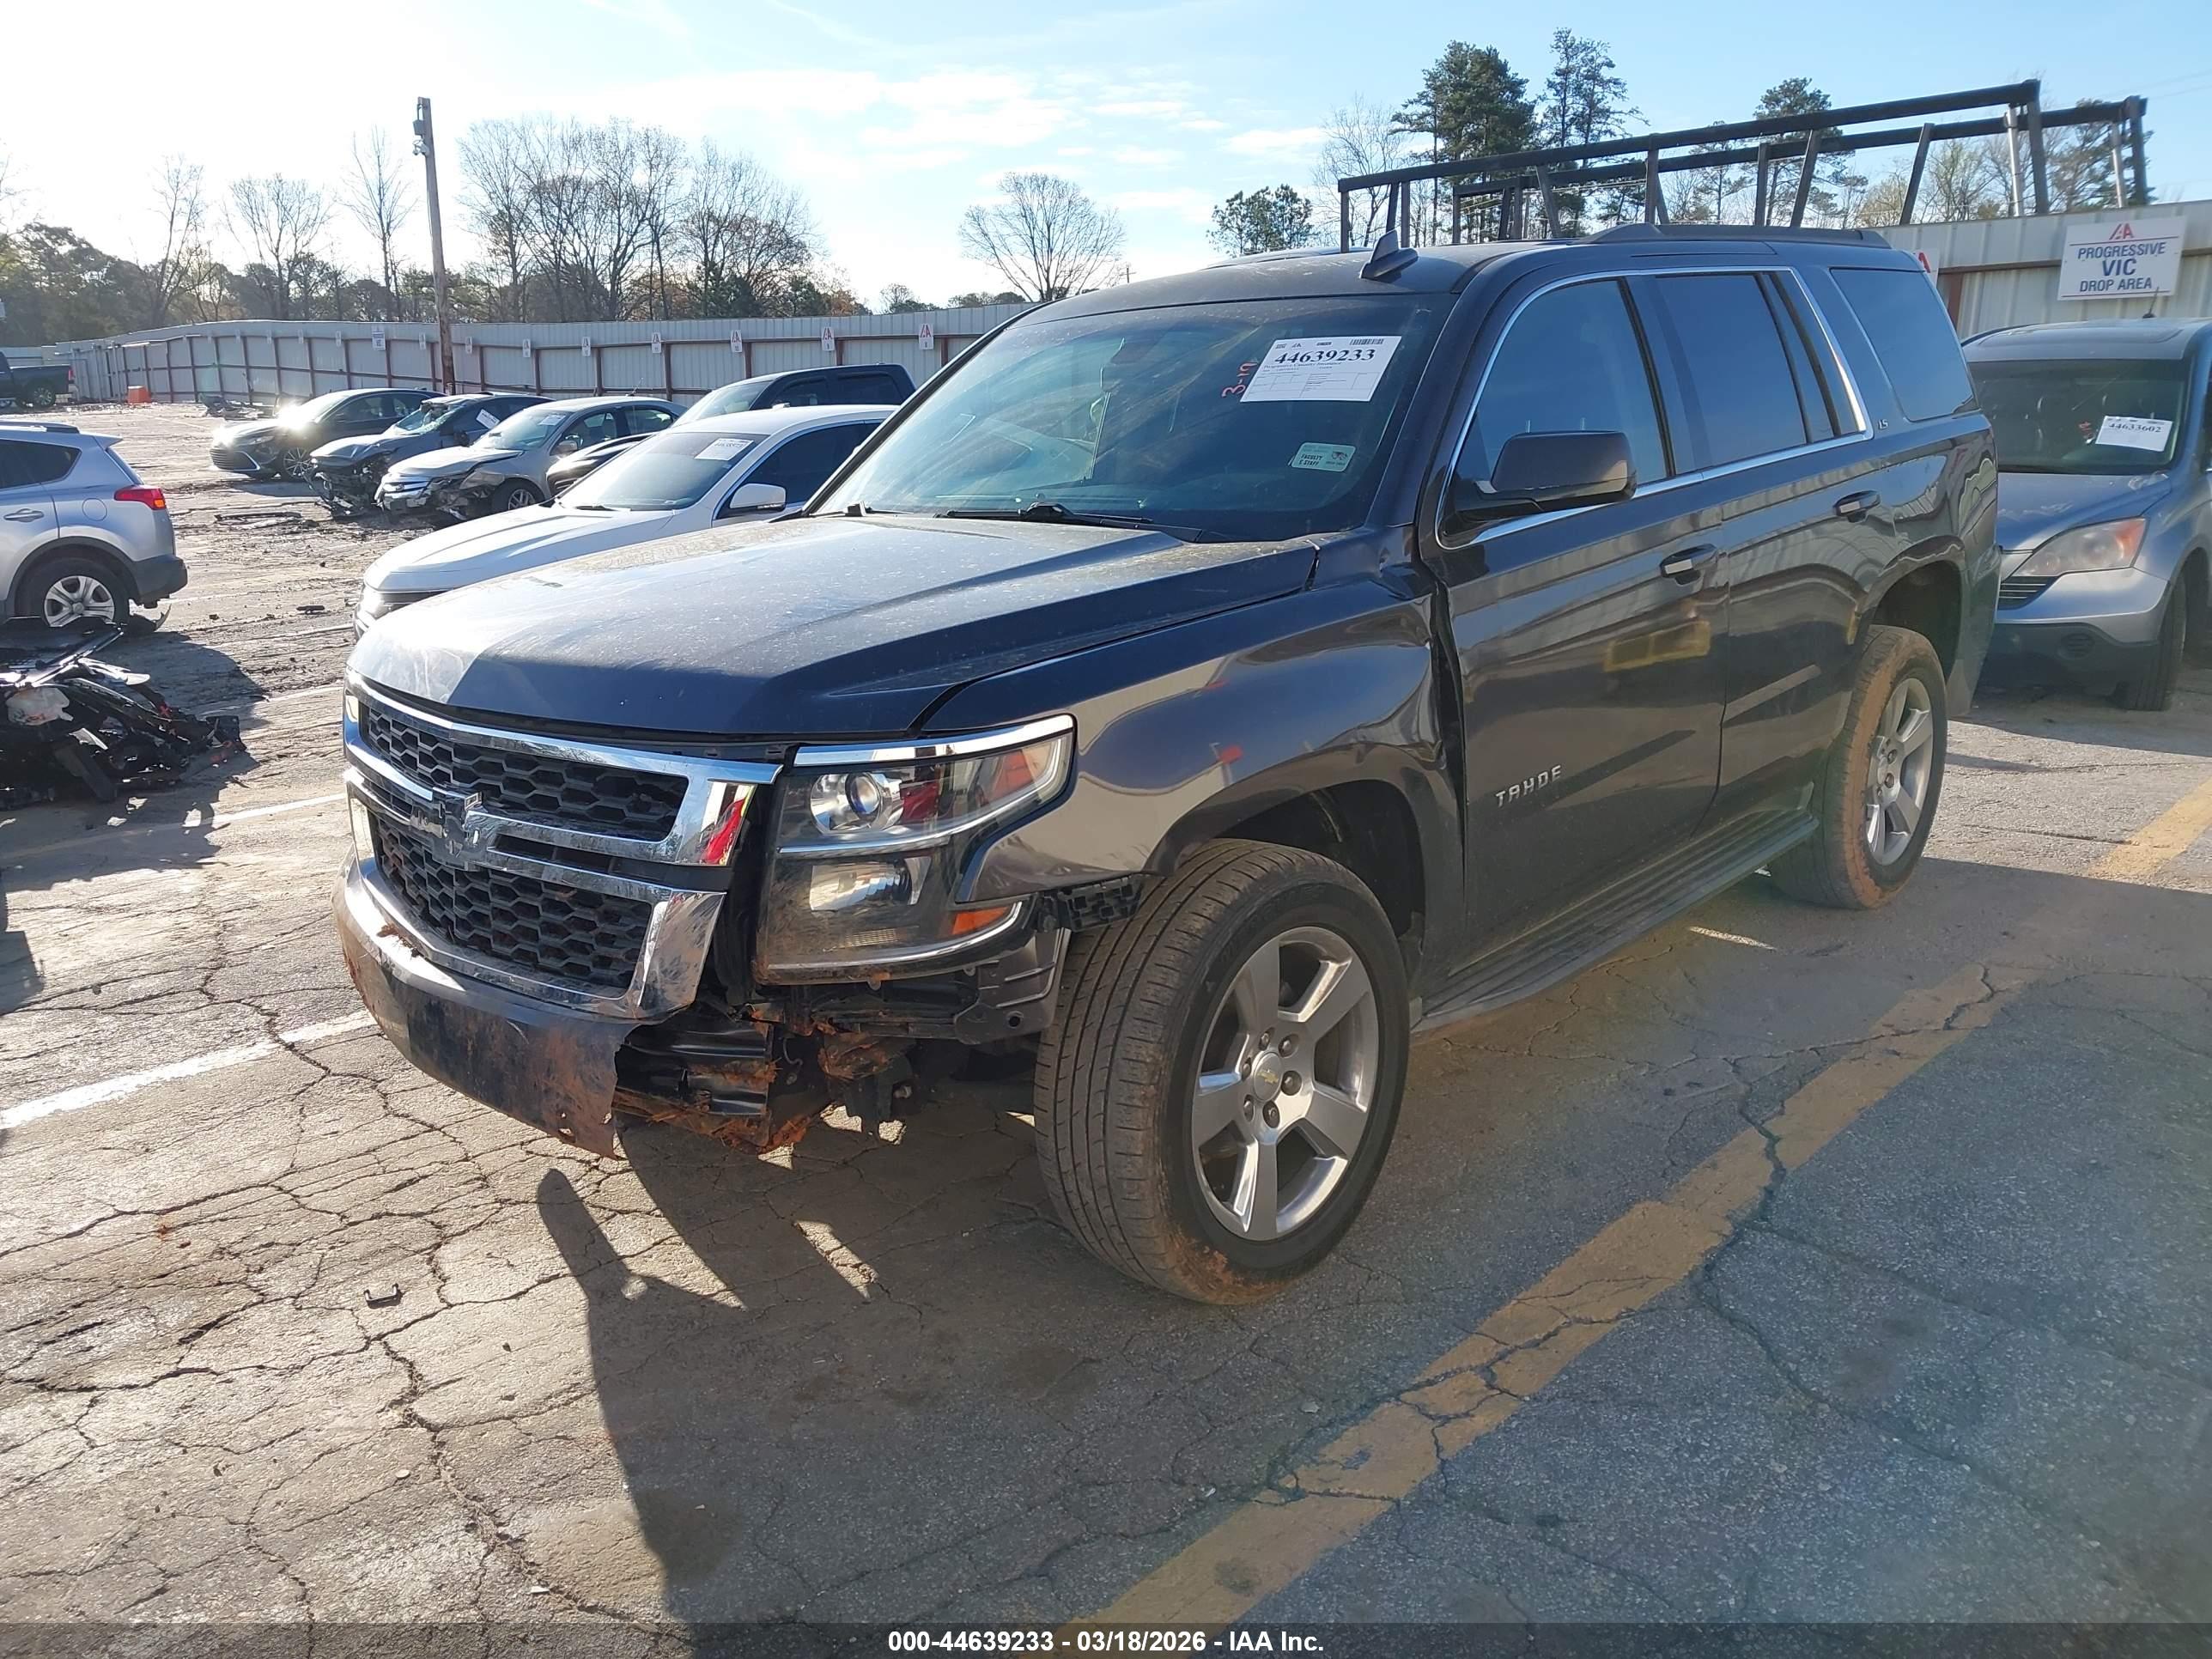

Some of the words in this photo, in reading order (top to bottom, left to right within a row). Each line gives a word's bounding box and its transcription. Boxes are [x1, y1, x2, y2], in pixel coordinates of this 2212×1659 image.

[2078, 241, 2166, 259] PROGRESSIVE
[2102, 258, 2136, 276] VIC
[2080, 279, 2114, 292] DROP
[2118, 277, 2152, 289] AREA
[1274, 349, 1376, 364] 44639233
[1495, 764, 1561, 808] TAHOE
